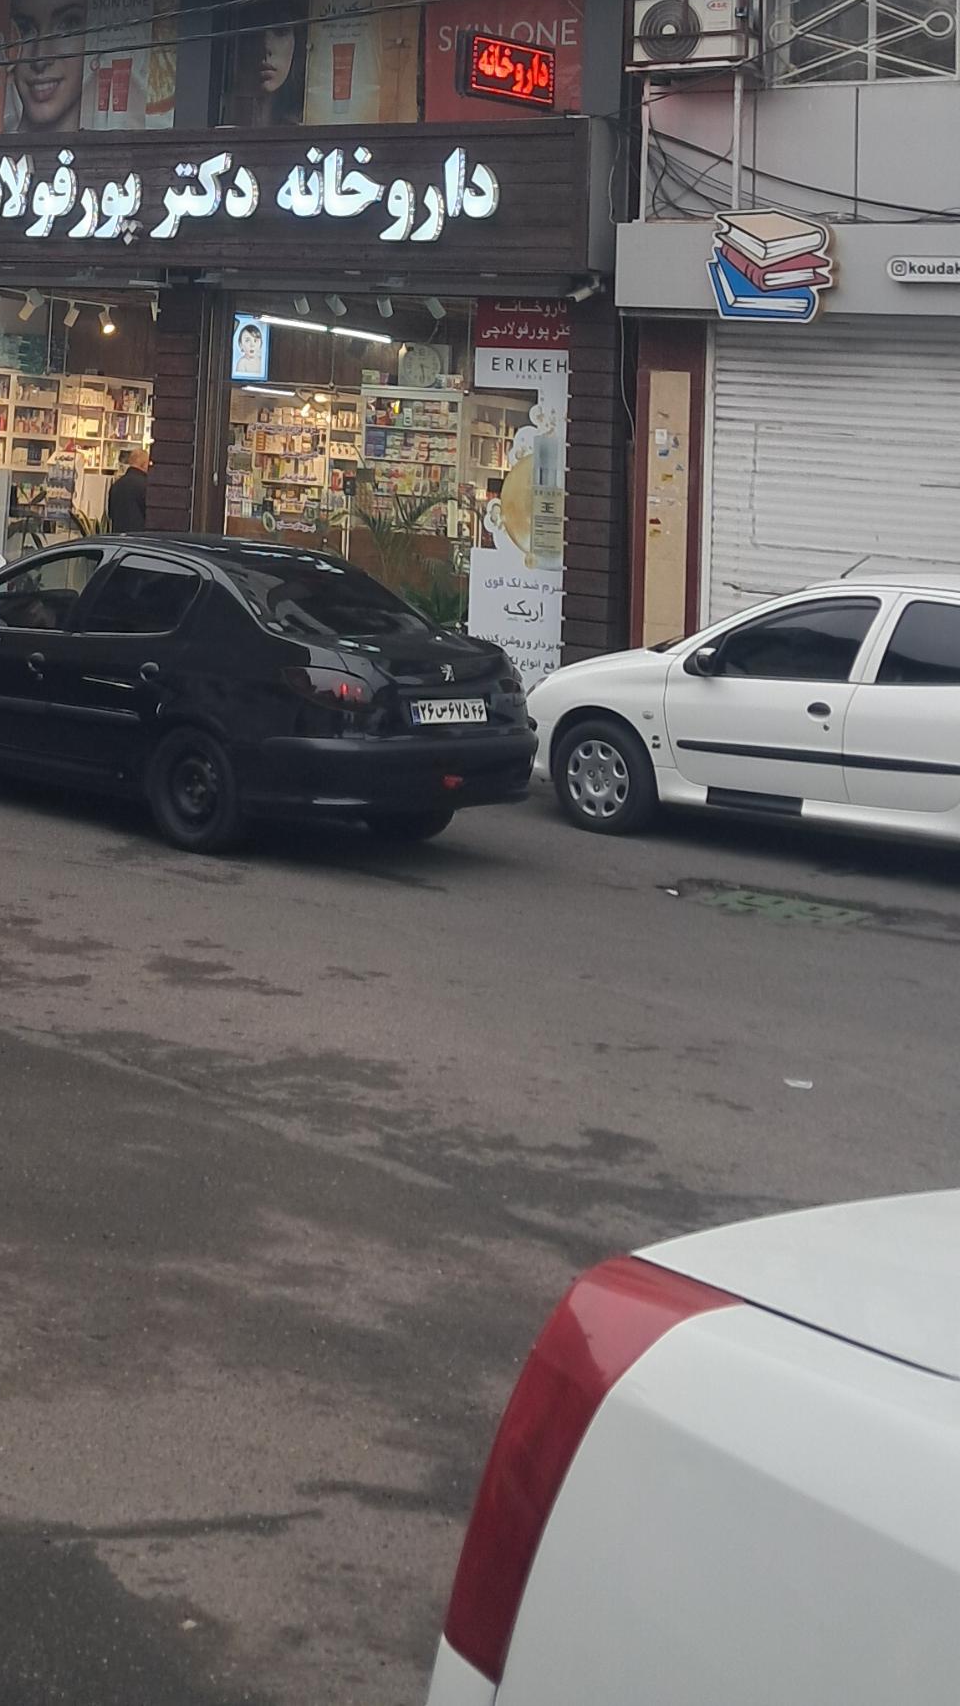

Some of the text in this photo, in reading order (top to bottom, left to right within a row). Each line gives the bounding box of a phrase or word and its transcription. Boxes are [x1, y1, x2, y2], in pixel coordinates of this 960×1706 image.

[511, 18, 578, 46] ONE
[477, 43, 549, 94] داروخانه
[149, 151, 261, 240] دکتر
[276, 145, 501, 243] داروخانه
[495, 299, 568, 318] داروخانه
[481, 321, 550, 341] پورفولادچی
[491, 356, 568, 374] ERIKEH
[484, 577, 504, 588] قوی
[503, 599, 544, 623] اریکه
